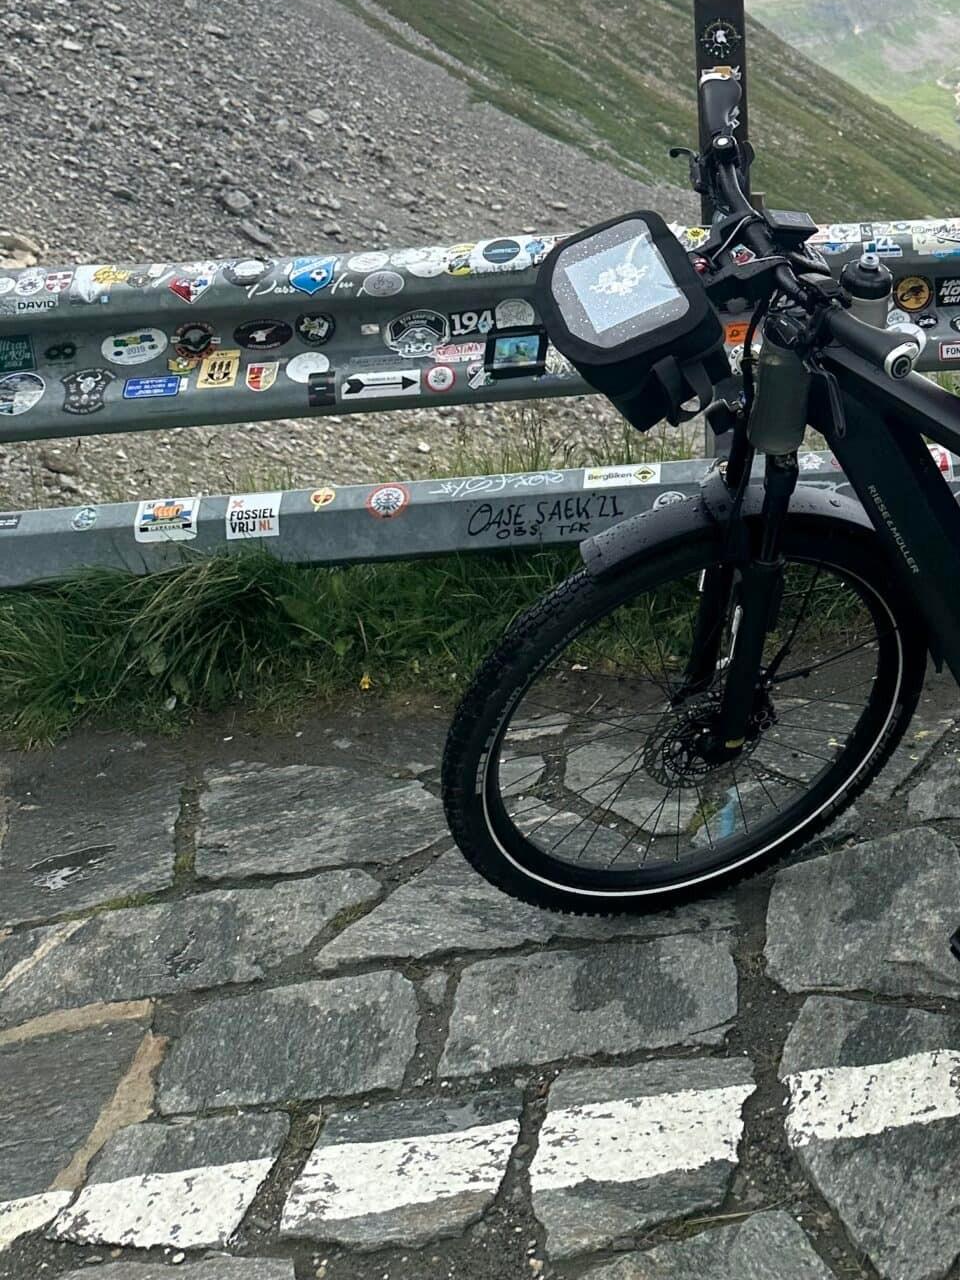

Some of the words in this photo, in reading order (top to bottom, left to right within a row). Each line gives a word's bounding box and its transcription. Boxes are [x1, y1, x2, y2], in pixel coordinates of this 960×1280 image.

[17, 300, 56, 311] DAVID
[942, 296, 960, 304] SKI
[229, 508, 276, 521] FOSSIEL
[229, 520, 256, 534] VRIJ
[258, 518, 274, 532] NL
